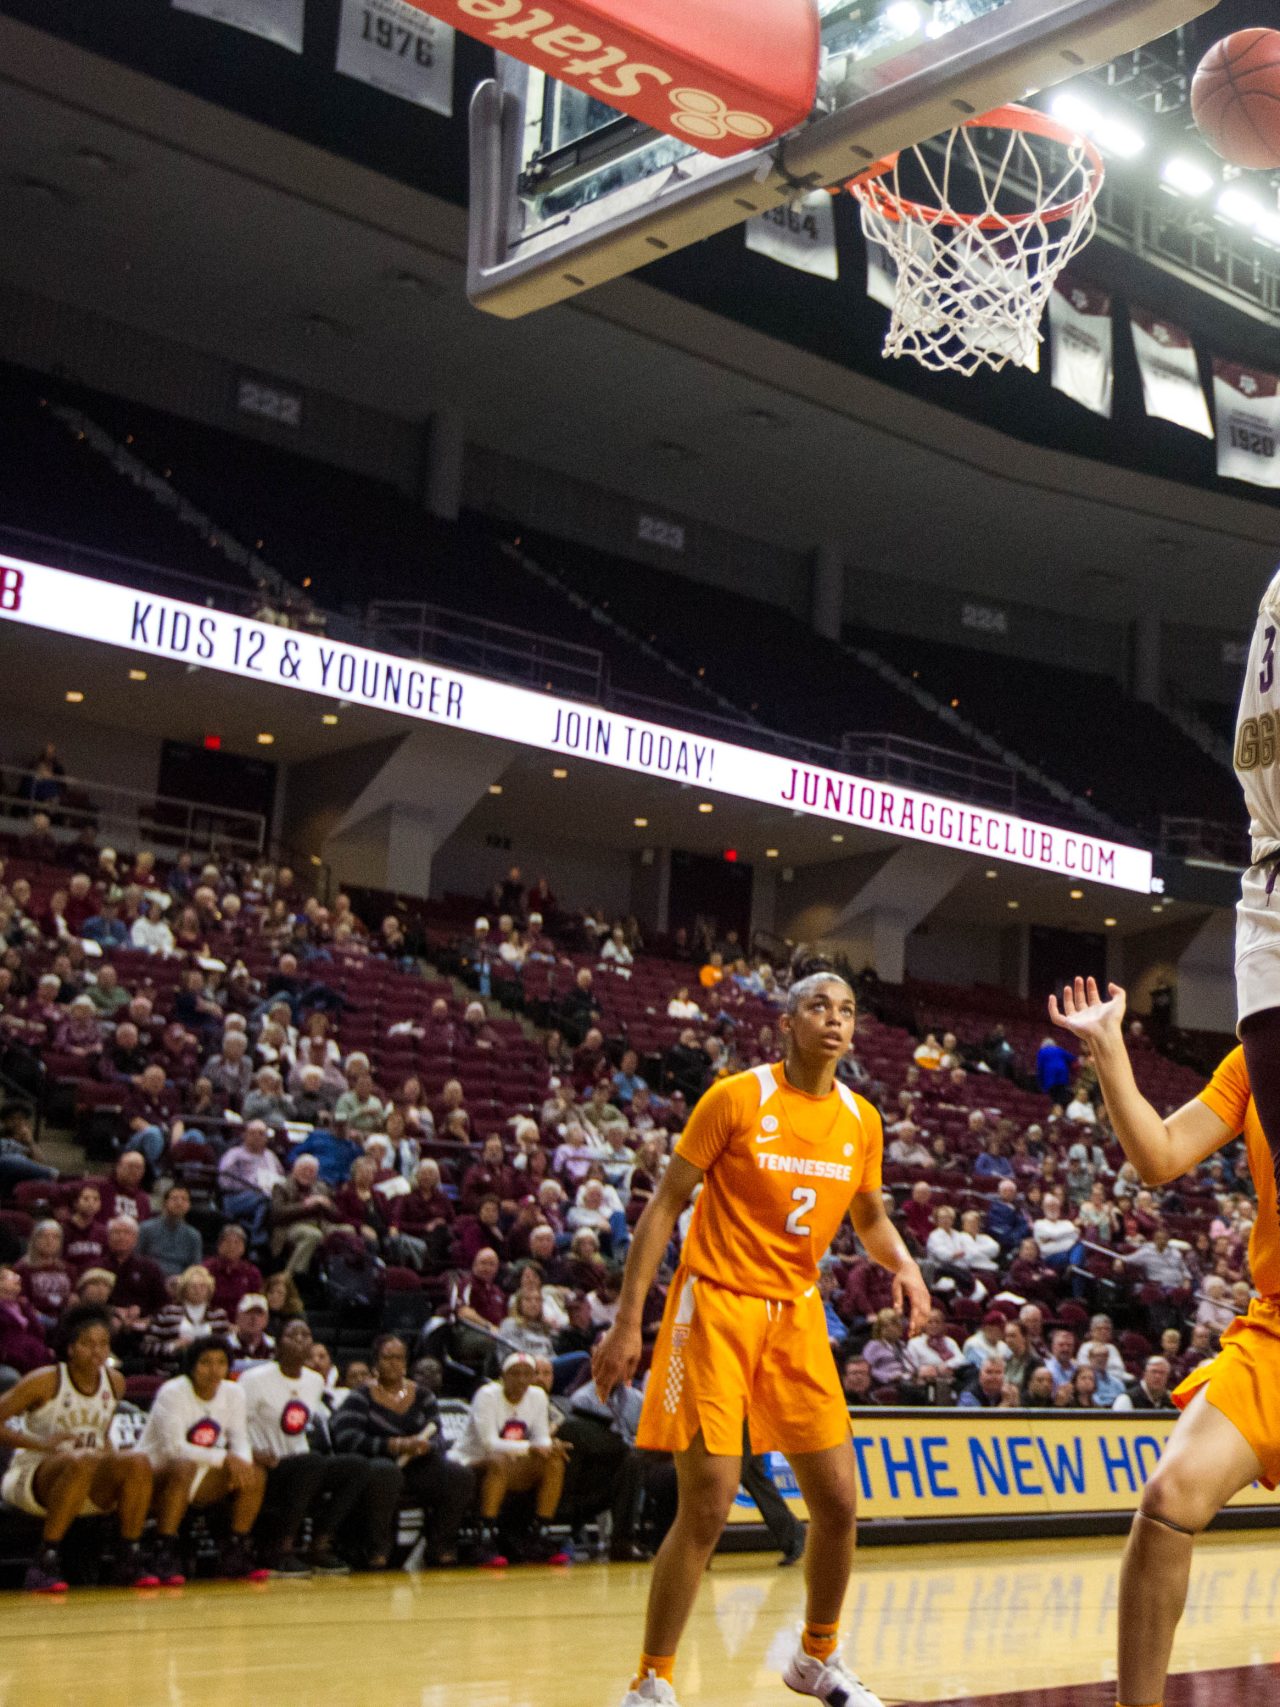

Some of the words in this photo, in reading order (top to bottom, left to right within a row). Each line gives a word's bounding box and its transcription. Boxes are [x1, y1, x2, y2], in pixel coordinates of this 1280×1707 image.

[358, 8, 436, 69] 1976
[456, 0, 673, 97] State
[131, 600, 216, 658] KIDS
[233, 626, 266, 671] 12
[280, 639, 302, 681] &
[319, 647, 464, 719] YOUNGER
[1259, 624, 1276, 694] 3
[551, 708, 611, 756] JOIN
[624, 725, 715, 782] TODAY!
[781, 768, 1116, 879] JUNIORAGGIECLUB.COM
[757, 1153, 851, 1181] TENNESSEE
[785, 1186, 818, 1236] 2
[852, 1436, 959, 1499] THE
[969, 1436, 1086, 1496] NEW
